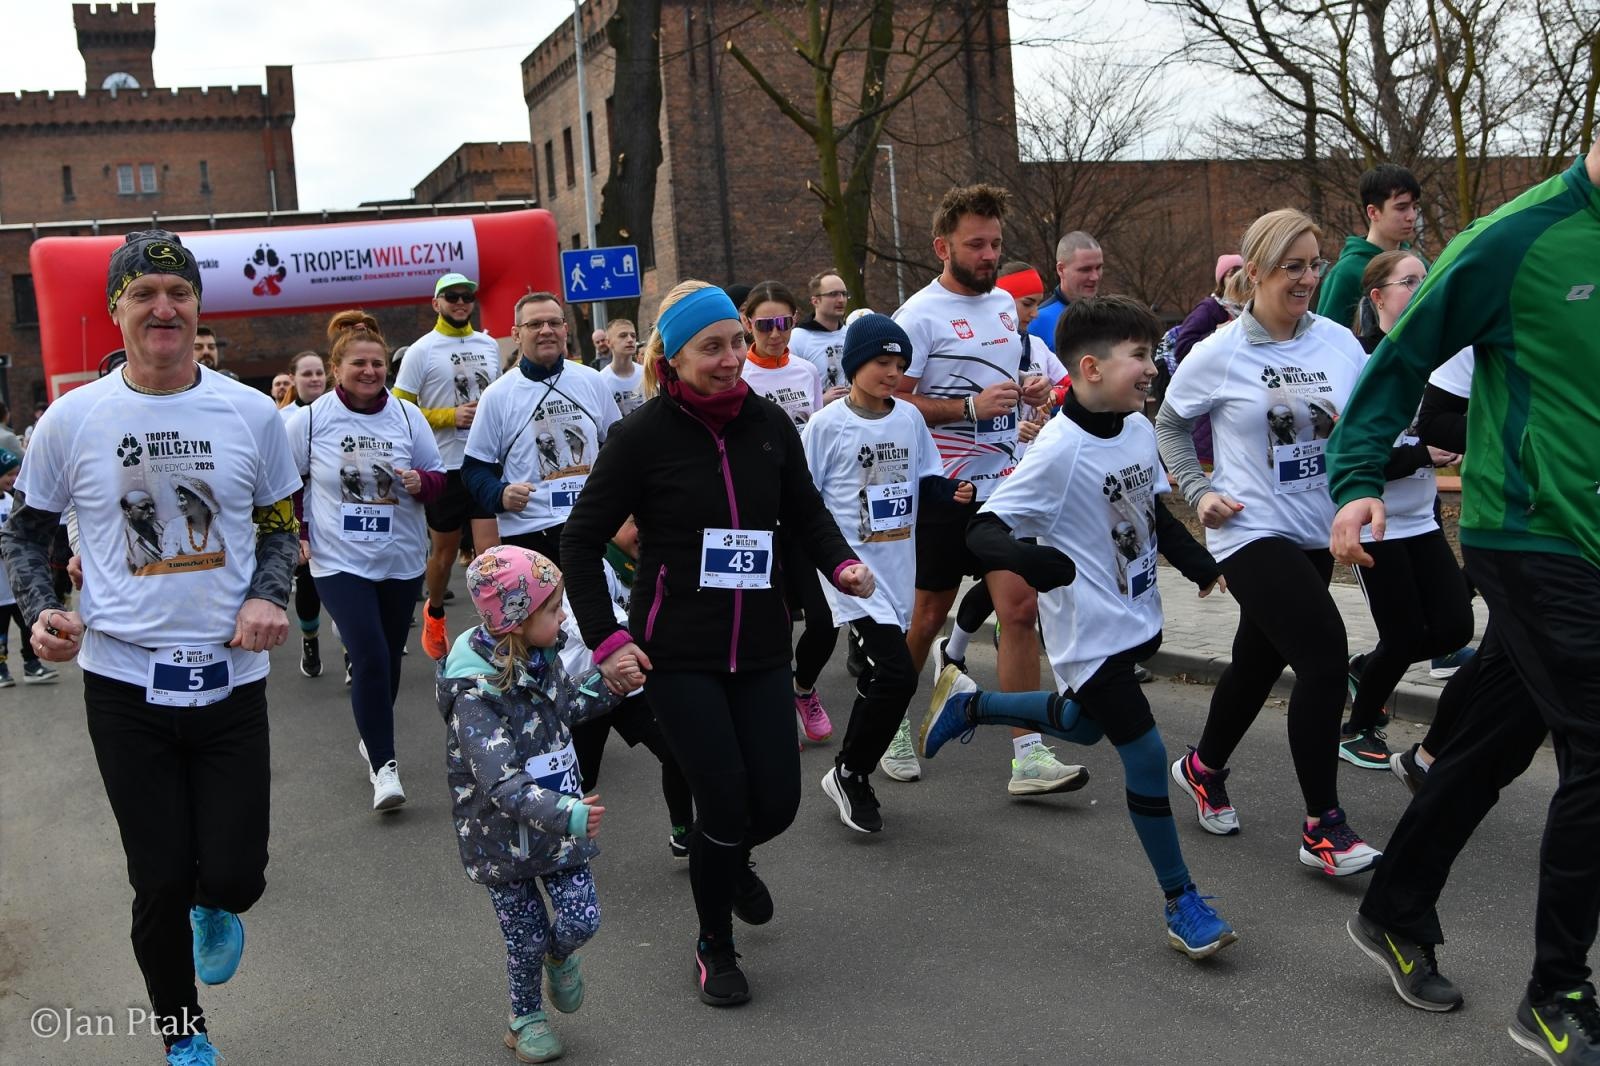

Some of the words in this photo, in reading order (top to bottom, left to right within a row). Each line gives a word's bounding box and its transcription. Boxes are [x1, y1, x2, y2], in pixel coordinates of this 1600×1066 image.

[290, 241, 464, 273] TROPEMWILCZYM
[1283, 371, 1328, 384] WILCZYM
[778, 390, 806, 402] WILCZYM
[547, 404, 579, 415] WILCZYM
[993, 415, 1009, 431] 80
[145, 431, 180, 442] TROPEM
[147, 440, 212, 456] WILCZYM
[359, 441, 393, 449] WILCZYM
[875, 442, 895, 450] TROPEM
[877, 448, 909, 460] WILCZYM
[164, 463, 194, 473] EDYCJA
[195, 461, 215, 470] 2026
[1119, 463, 1141, 477] TROPEM
[1299, 457, 1318, 478] 55
[1123, 466, 1153, 490] WILCZY
[889, 498, 907, 515] 79
[360, 517, 378, 531] 14
[728, 551, 754, 572] 43
[186, 653, 213, 663] WILCZYM
[188, 668, 204, 690] 5
[560, 767, 578, 793] 45
